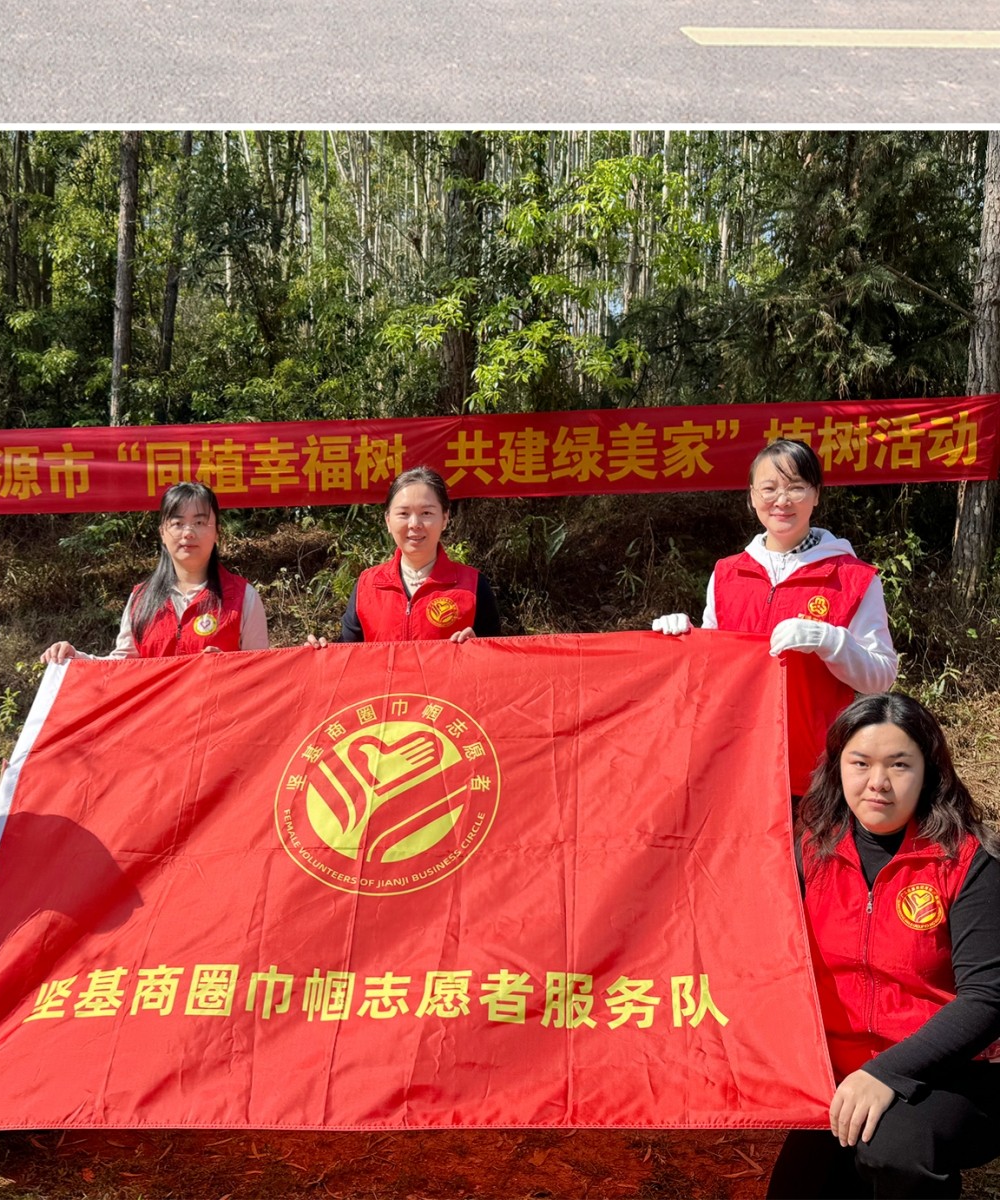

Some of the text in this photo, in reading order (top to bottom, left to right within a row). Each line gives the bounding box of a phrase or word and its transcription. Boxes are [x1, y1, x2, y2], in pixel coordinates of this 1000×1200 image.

[286, 699, 491, 791] 坚基商圈巾帼志愿者
[284, 808, 486, 889] FEMALE VOLUNTEERS OF JIANJI BUSINESS CIRCLE
[23, 963, 729, 1030] 坚基商圈巾帼志愿者服务队
